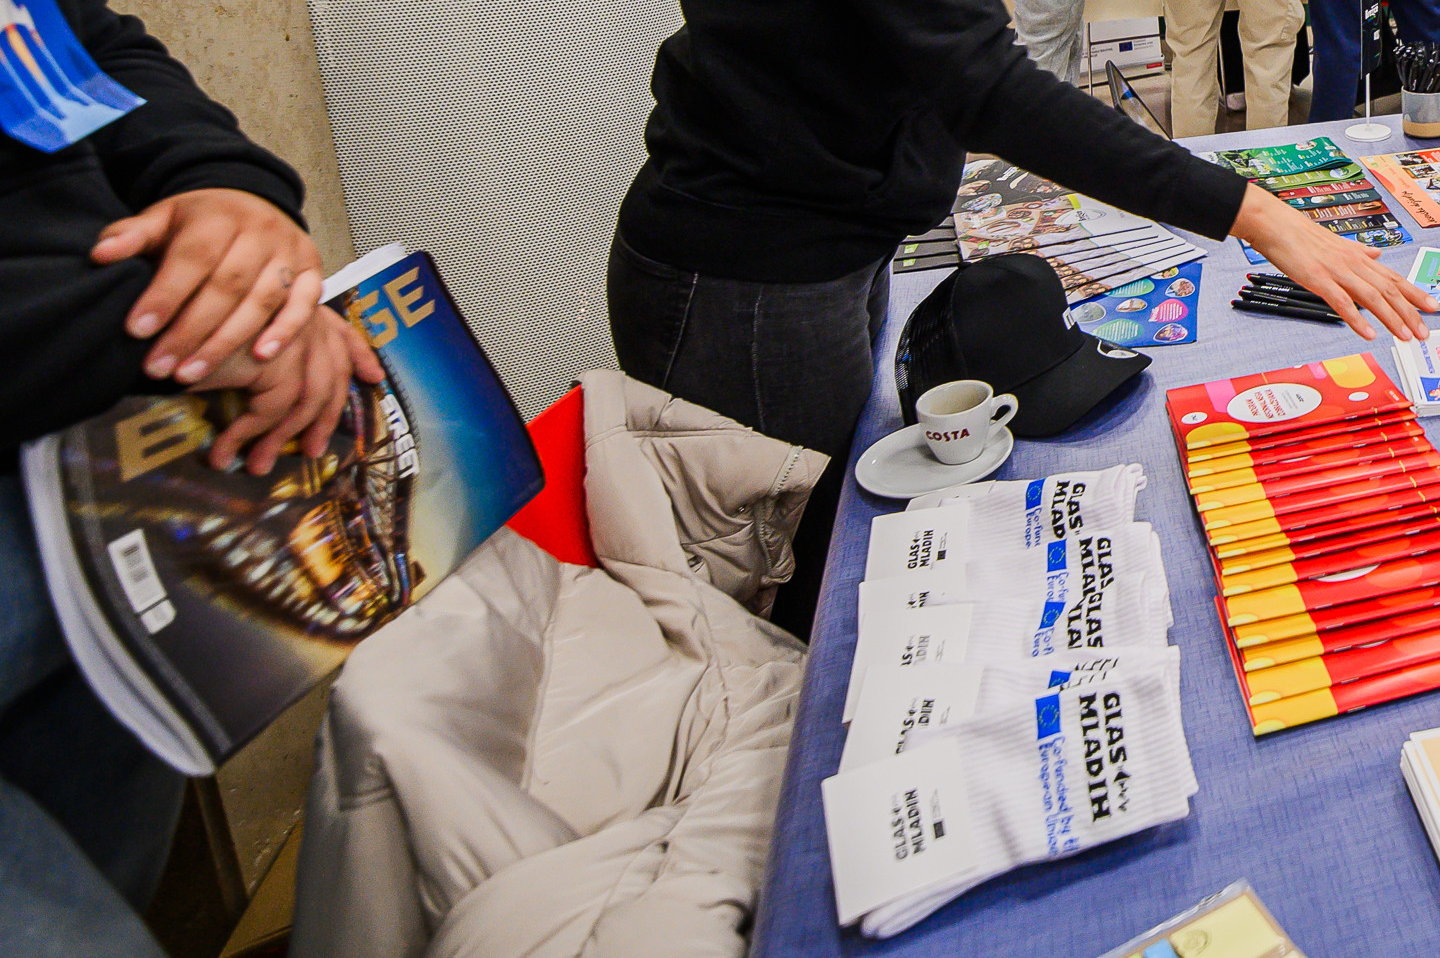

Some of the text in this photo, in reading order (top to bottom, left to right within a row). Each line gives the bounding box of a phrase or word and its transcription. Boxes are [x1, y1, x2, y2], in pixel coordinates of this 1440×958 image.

[379, 392, 418, 479] STREET
[926, 428, 970, 442] COSTA
[1025, 512, 1033, 549] Europe
[1052, 480, 1071, 539] MLAD
[1066, 482, 1087, 531] GLAS
[907, 544, 920, 569] GLAS
[1103, 692, 1128, 764] GLAS
[1053, 736, 1072, 813] Co-funded
[1079, 692, 1112, 822] MLADIH
[892, 818, 908, 860] GLAS
